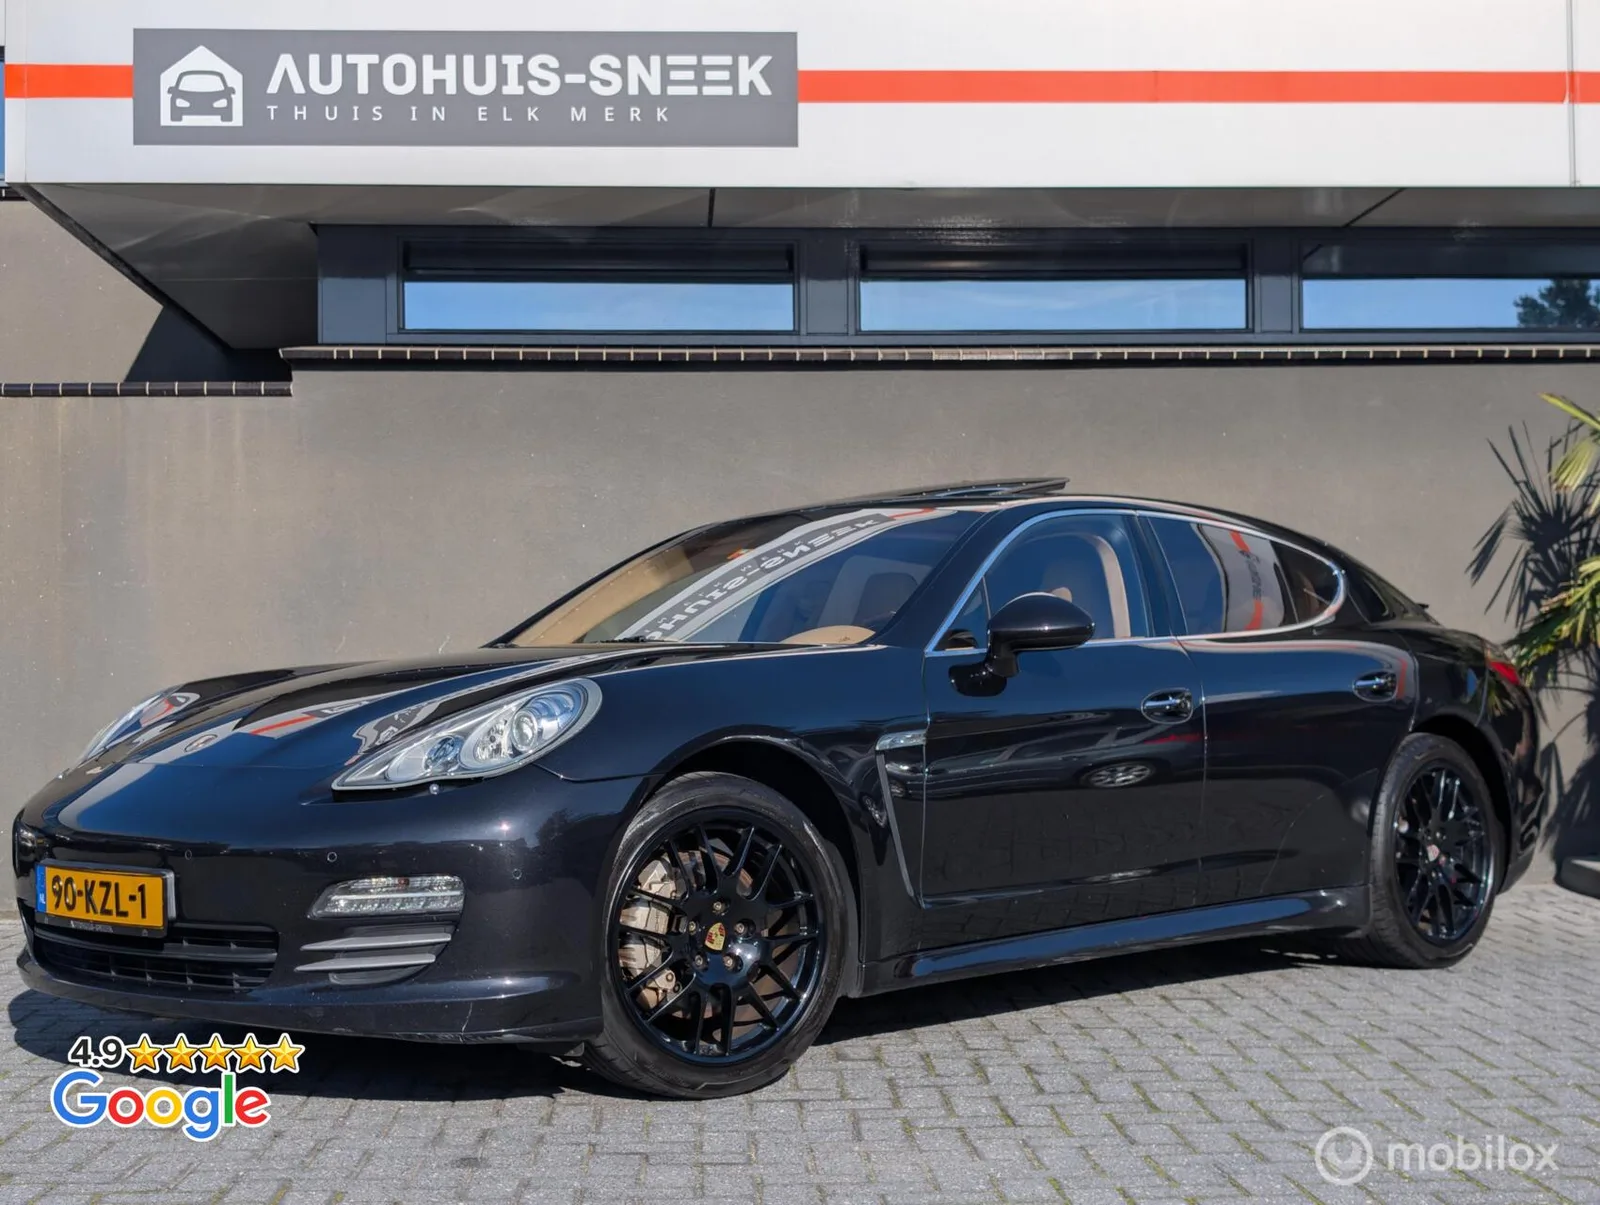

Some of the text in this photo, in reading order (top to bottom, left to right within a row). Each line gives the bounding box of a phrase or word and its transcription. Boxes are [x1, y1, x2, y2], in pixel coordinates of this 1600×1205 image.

[266, 54, 773, 96] AUTOHUIS-SNEEK
[266, 105, 668, 122] THUIS IN ELK MERK
[51, 874, 147, 919] 90-KZL-1
